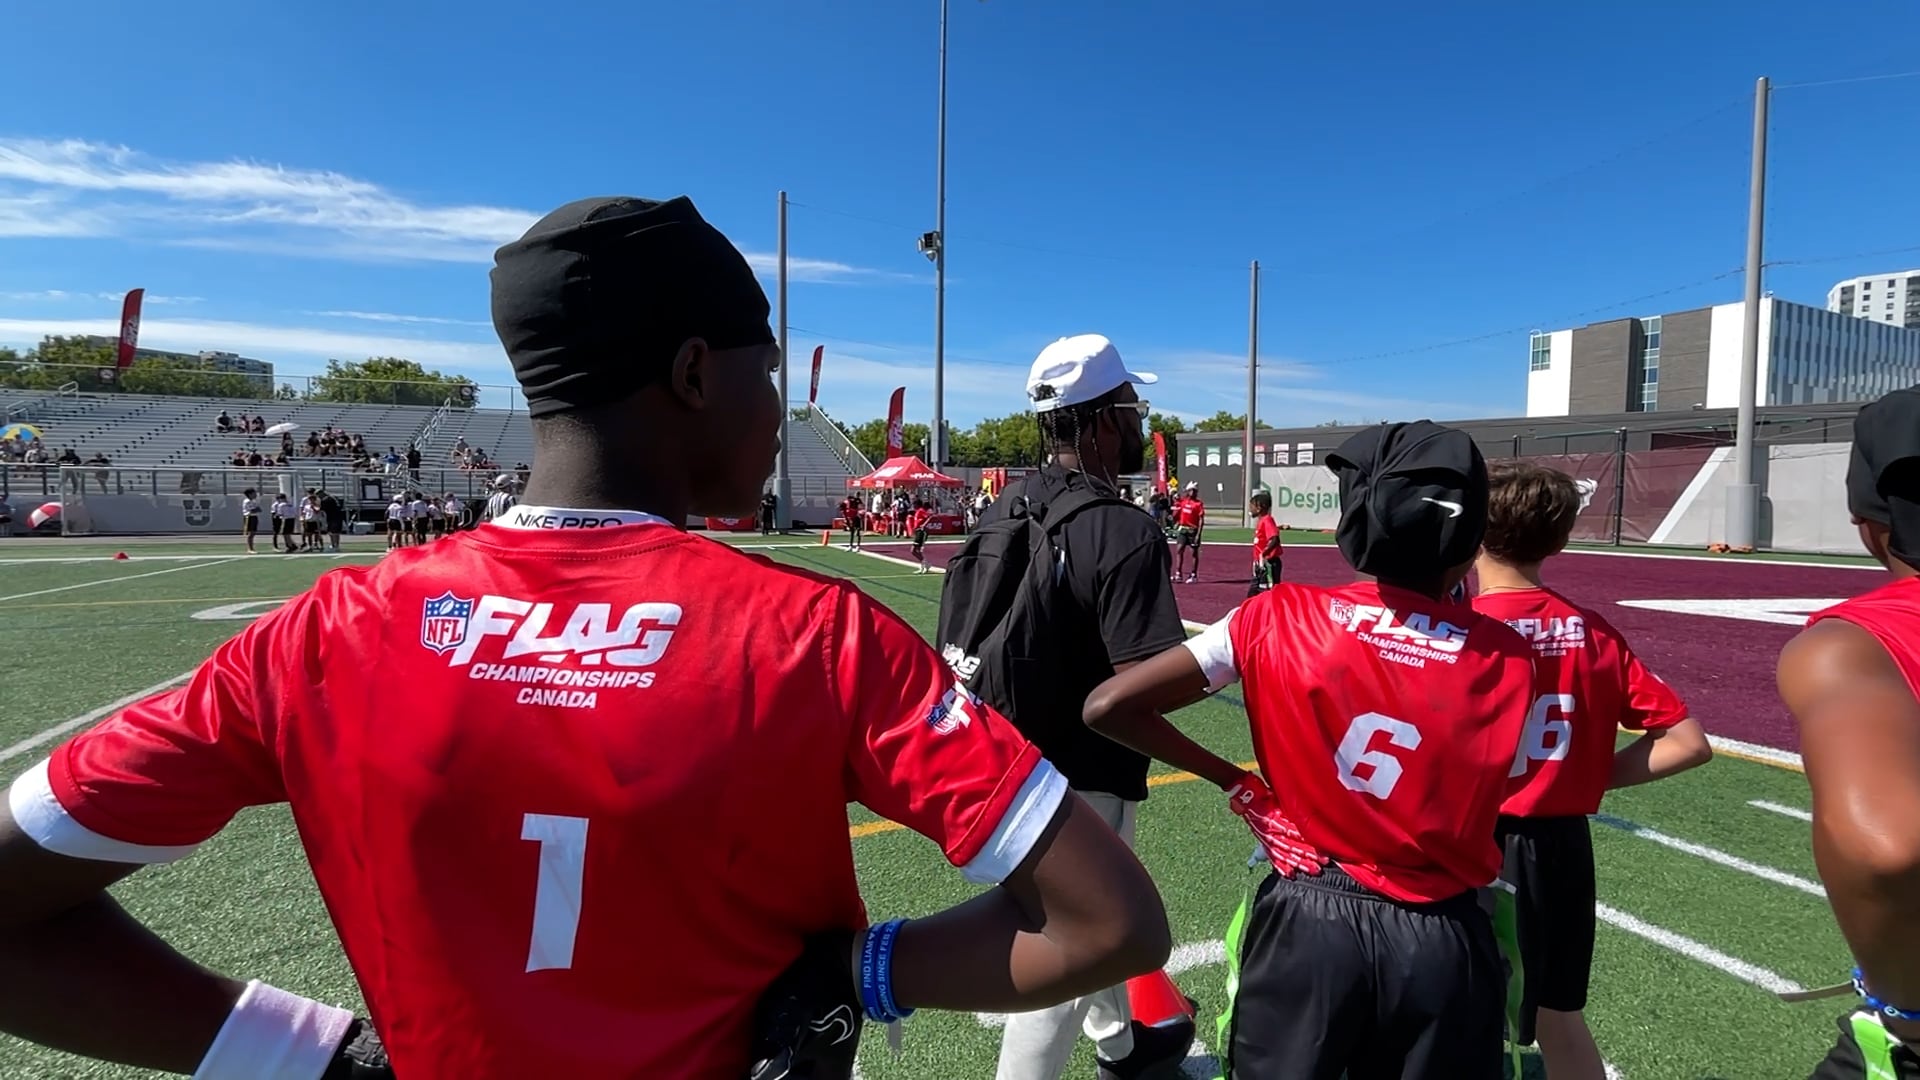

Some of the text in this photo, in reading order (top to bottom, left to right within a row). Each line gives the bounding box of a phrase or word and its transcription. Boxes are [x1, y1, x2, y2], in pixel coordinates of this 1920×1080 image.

[515, 513, 558, 529] NIKE
[427, 595, 682, 667] NFL FLAG
[1346, 604, 1469, 653] FLAG
[1518, 615, 1585, 641] FLAG
[1357, 632, 1458, 665] CHAMPIONSHIPS
[1379, 650, 1425, 669] CANADA
[469, 662, 655, 689] CHAMPIONSHIPS
[516, 687, 597, 709] CANADA
[1334, 712, 1422, 800] 6
[520, 813, 589, 973] 1
[880, 933, 891, 951] FEB
[863, 941, 874, 988] FIND LIAM
[878, 954, 887, 982] SINCE
